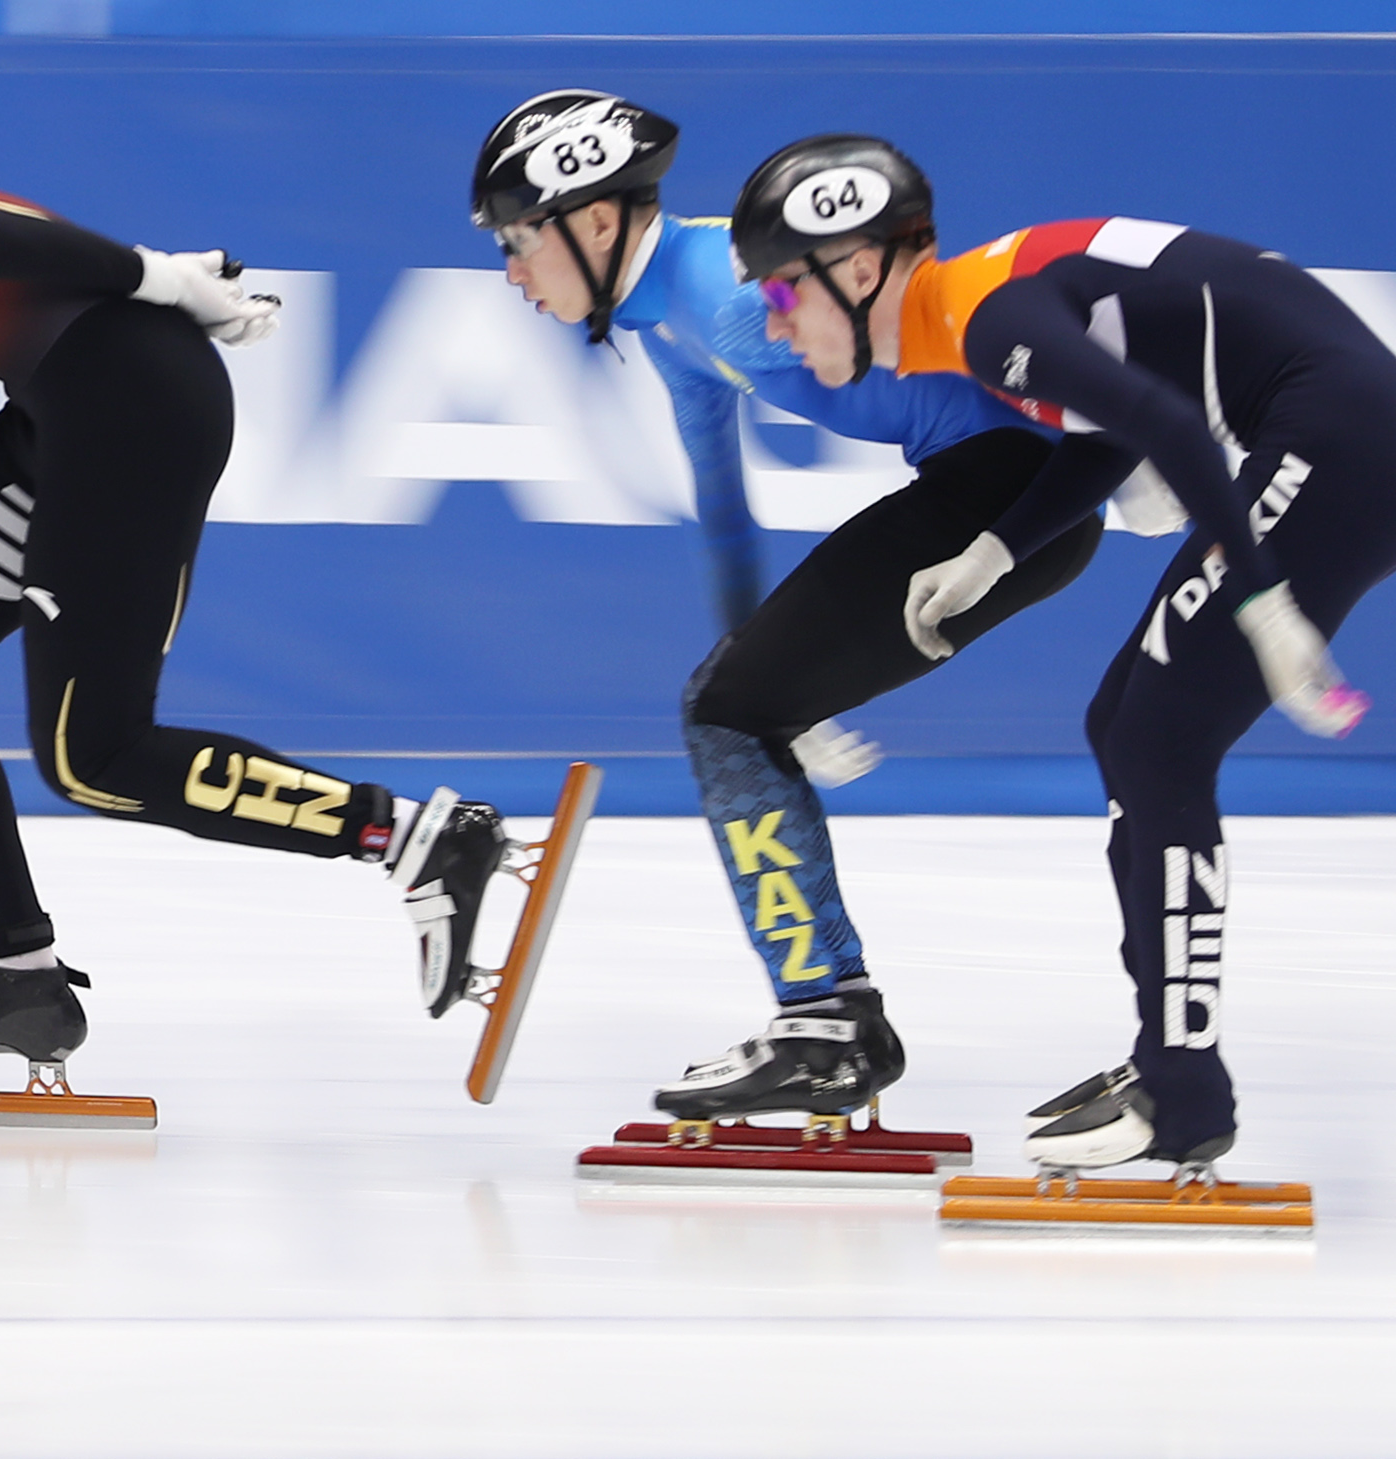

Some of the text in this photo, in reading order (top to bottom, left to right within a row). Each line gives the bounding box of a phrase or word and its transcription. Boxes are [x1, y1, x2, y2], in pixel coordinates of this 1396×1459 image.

[552, 134, 607, 176] 83
[810, 177, 864, 220] 64
[184, 747, 351, 836] CHN
[724, 810, 831, 982] KAZ
[1163, 843, 1227, 1050] NED
